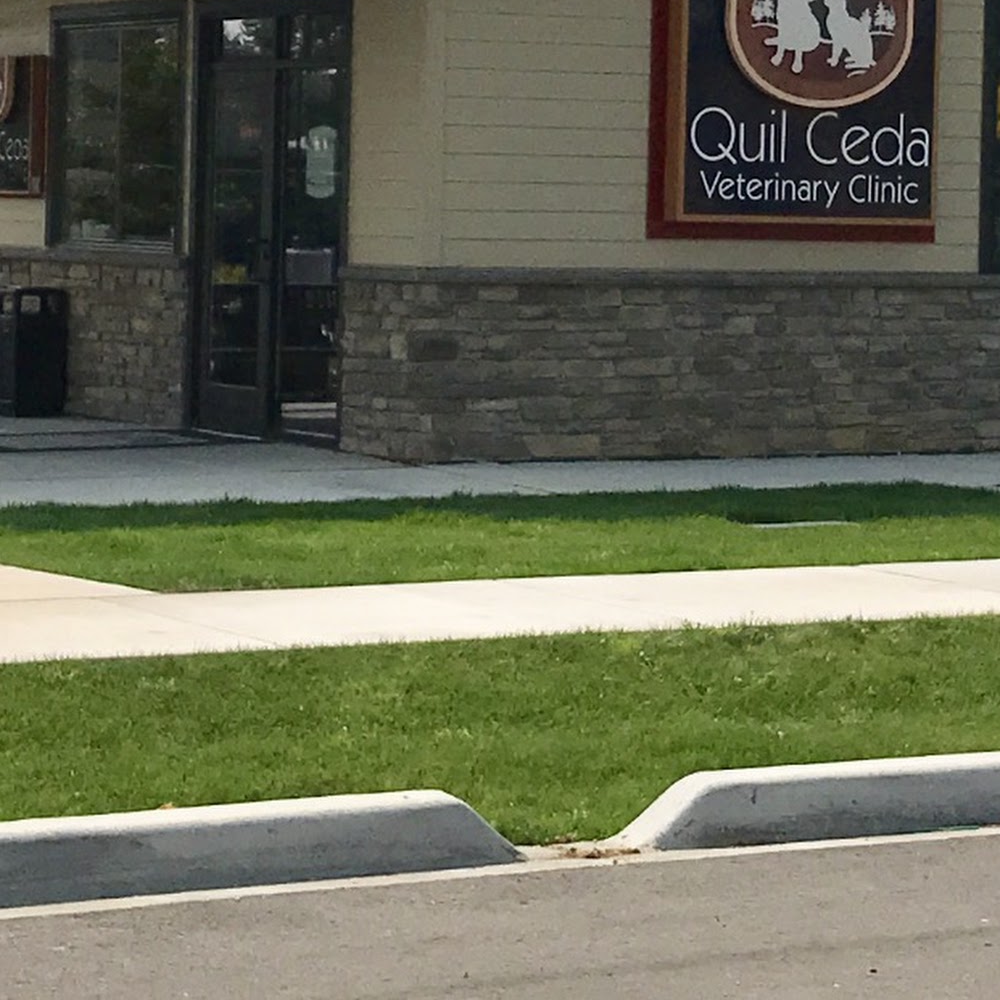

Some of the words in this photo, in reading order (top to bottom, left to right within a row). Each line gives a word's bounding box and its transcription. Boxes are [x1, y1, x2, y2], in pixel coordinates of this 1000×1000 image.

[690, 106, 787, 164] Quil
[806, 111, 929, 166] Ceda
[700, 170, 840, 208] Veterinary
[849, 174, 918, 204] Clinic
